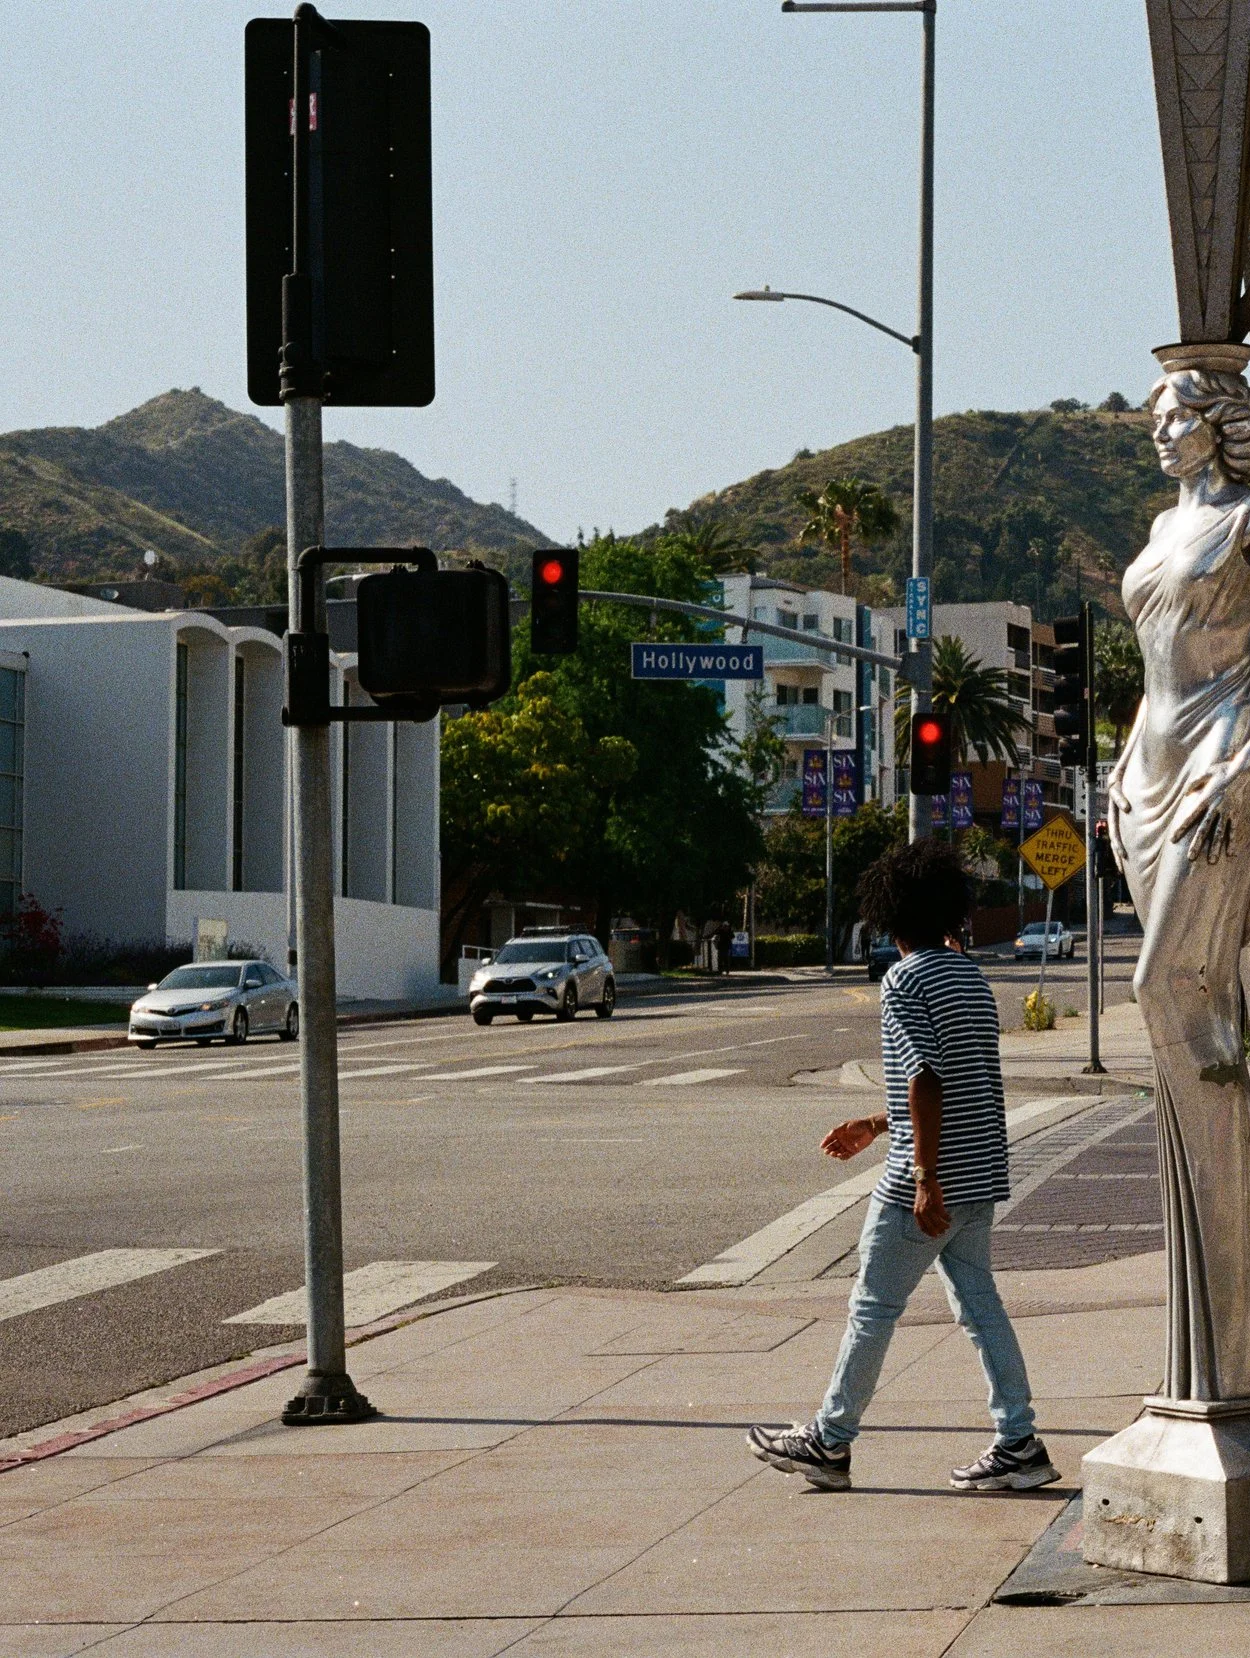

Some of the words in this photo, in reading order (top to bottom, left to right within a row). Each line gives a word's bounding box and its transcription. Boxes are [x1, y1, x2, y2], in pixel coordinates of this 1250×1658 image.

[642, 651, 754, 674] Hollywood
[833, 753, 856, 769] SIX
[804, 772, 826, 787] SIX
[952, 776, 972, 789] SIX
[1025, 783, 1043, 795] SIX
[833, 789, 856, 804] SIX
[1003, 795, 1020, 807] SIX
[952, 806, 973, 818] SIX
[1024, 810, 1043, 821] SIX
[1046, 827, 1073, 840] THRU
[1035, 839, 1078, 853] TRAFFIC
[1034, 853, 1076, 865] MERGE
[1041, 866, 1067, 877] LEFT
